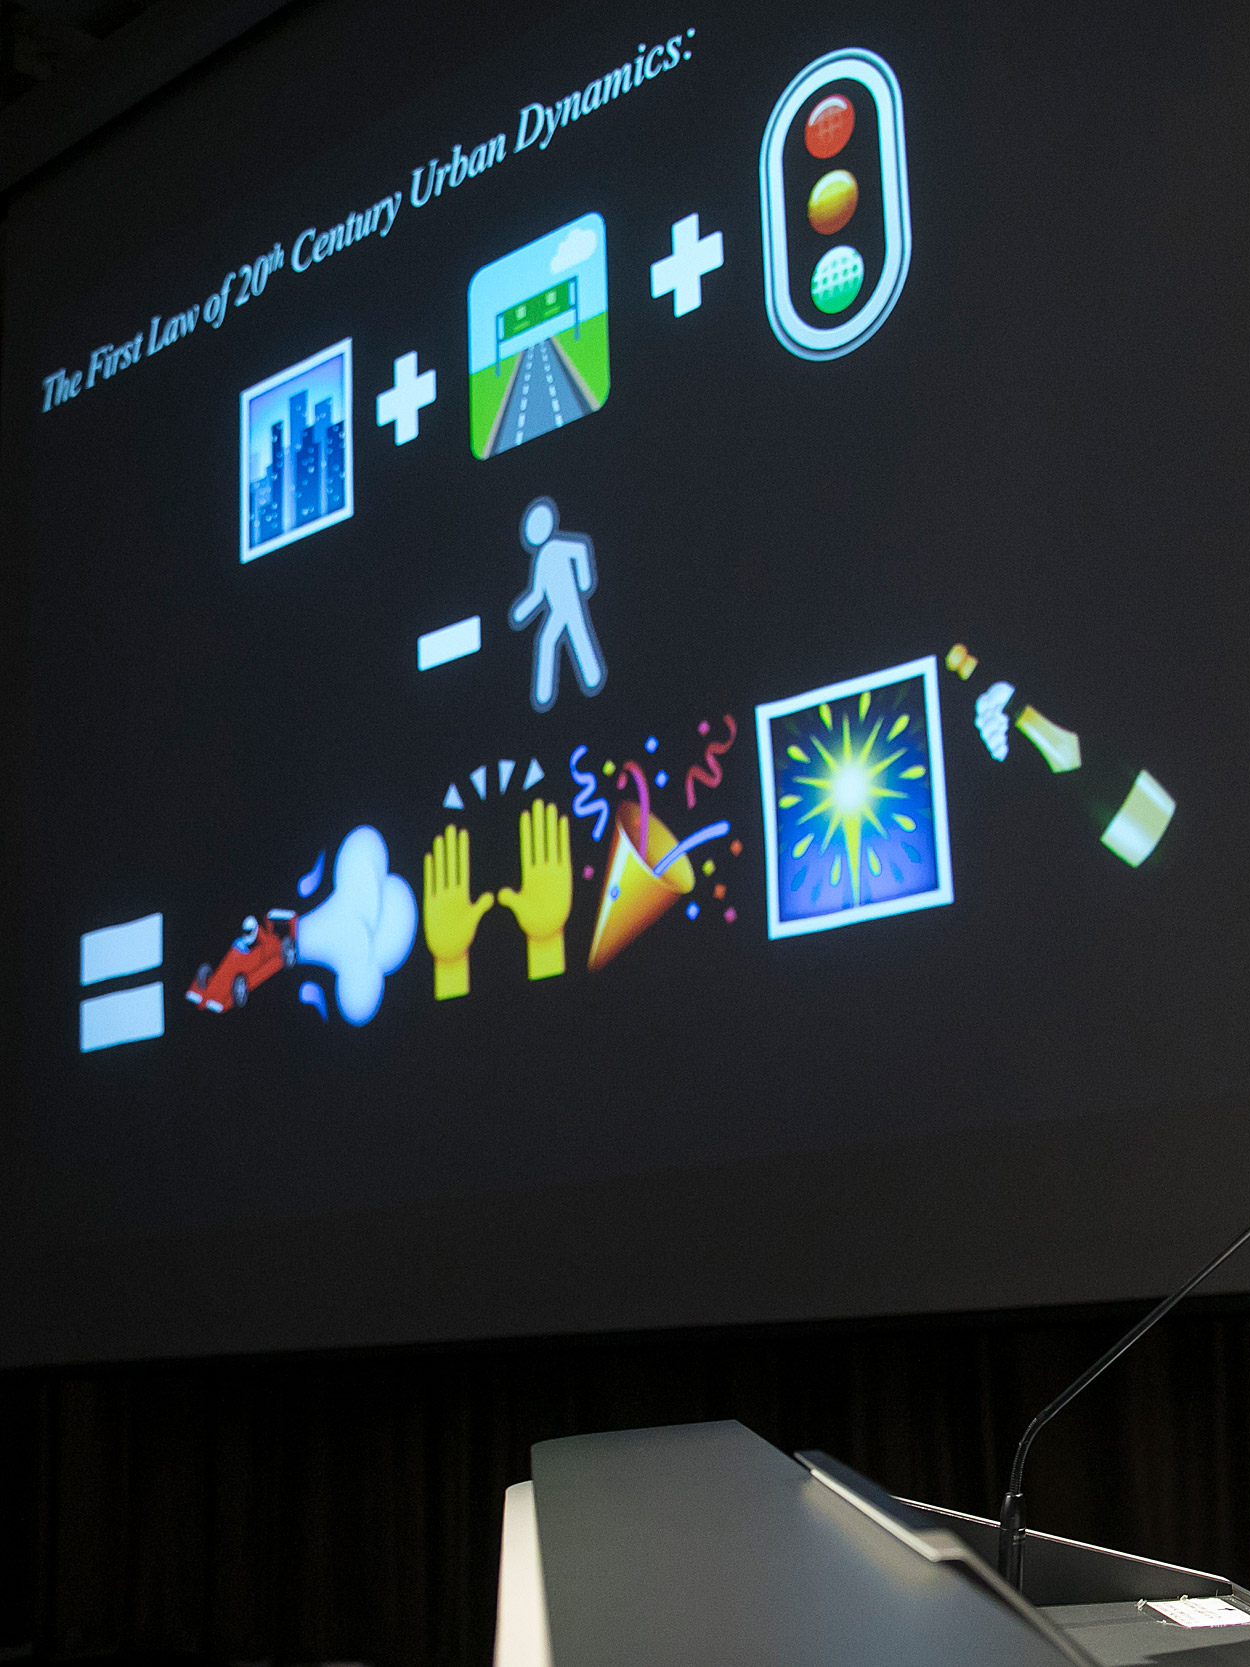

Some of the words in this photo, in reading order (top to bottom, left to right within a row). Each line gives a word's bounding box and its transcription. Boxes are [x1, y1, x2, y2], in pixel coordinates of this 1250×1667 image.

[42, 367, 83, 413] The
[85, 332, 144, 390] First
[146, 303, 200, 357] Law
[203, 271, 237, 329] of
[233, 242, 284, 307] 20th
[291, 190, 402, 273] Century
[410, 132, 507, 208] Urban
[512, 27, 696, 154] Dynamics:
